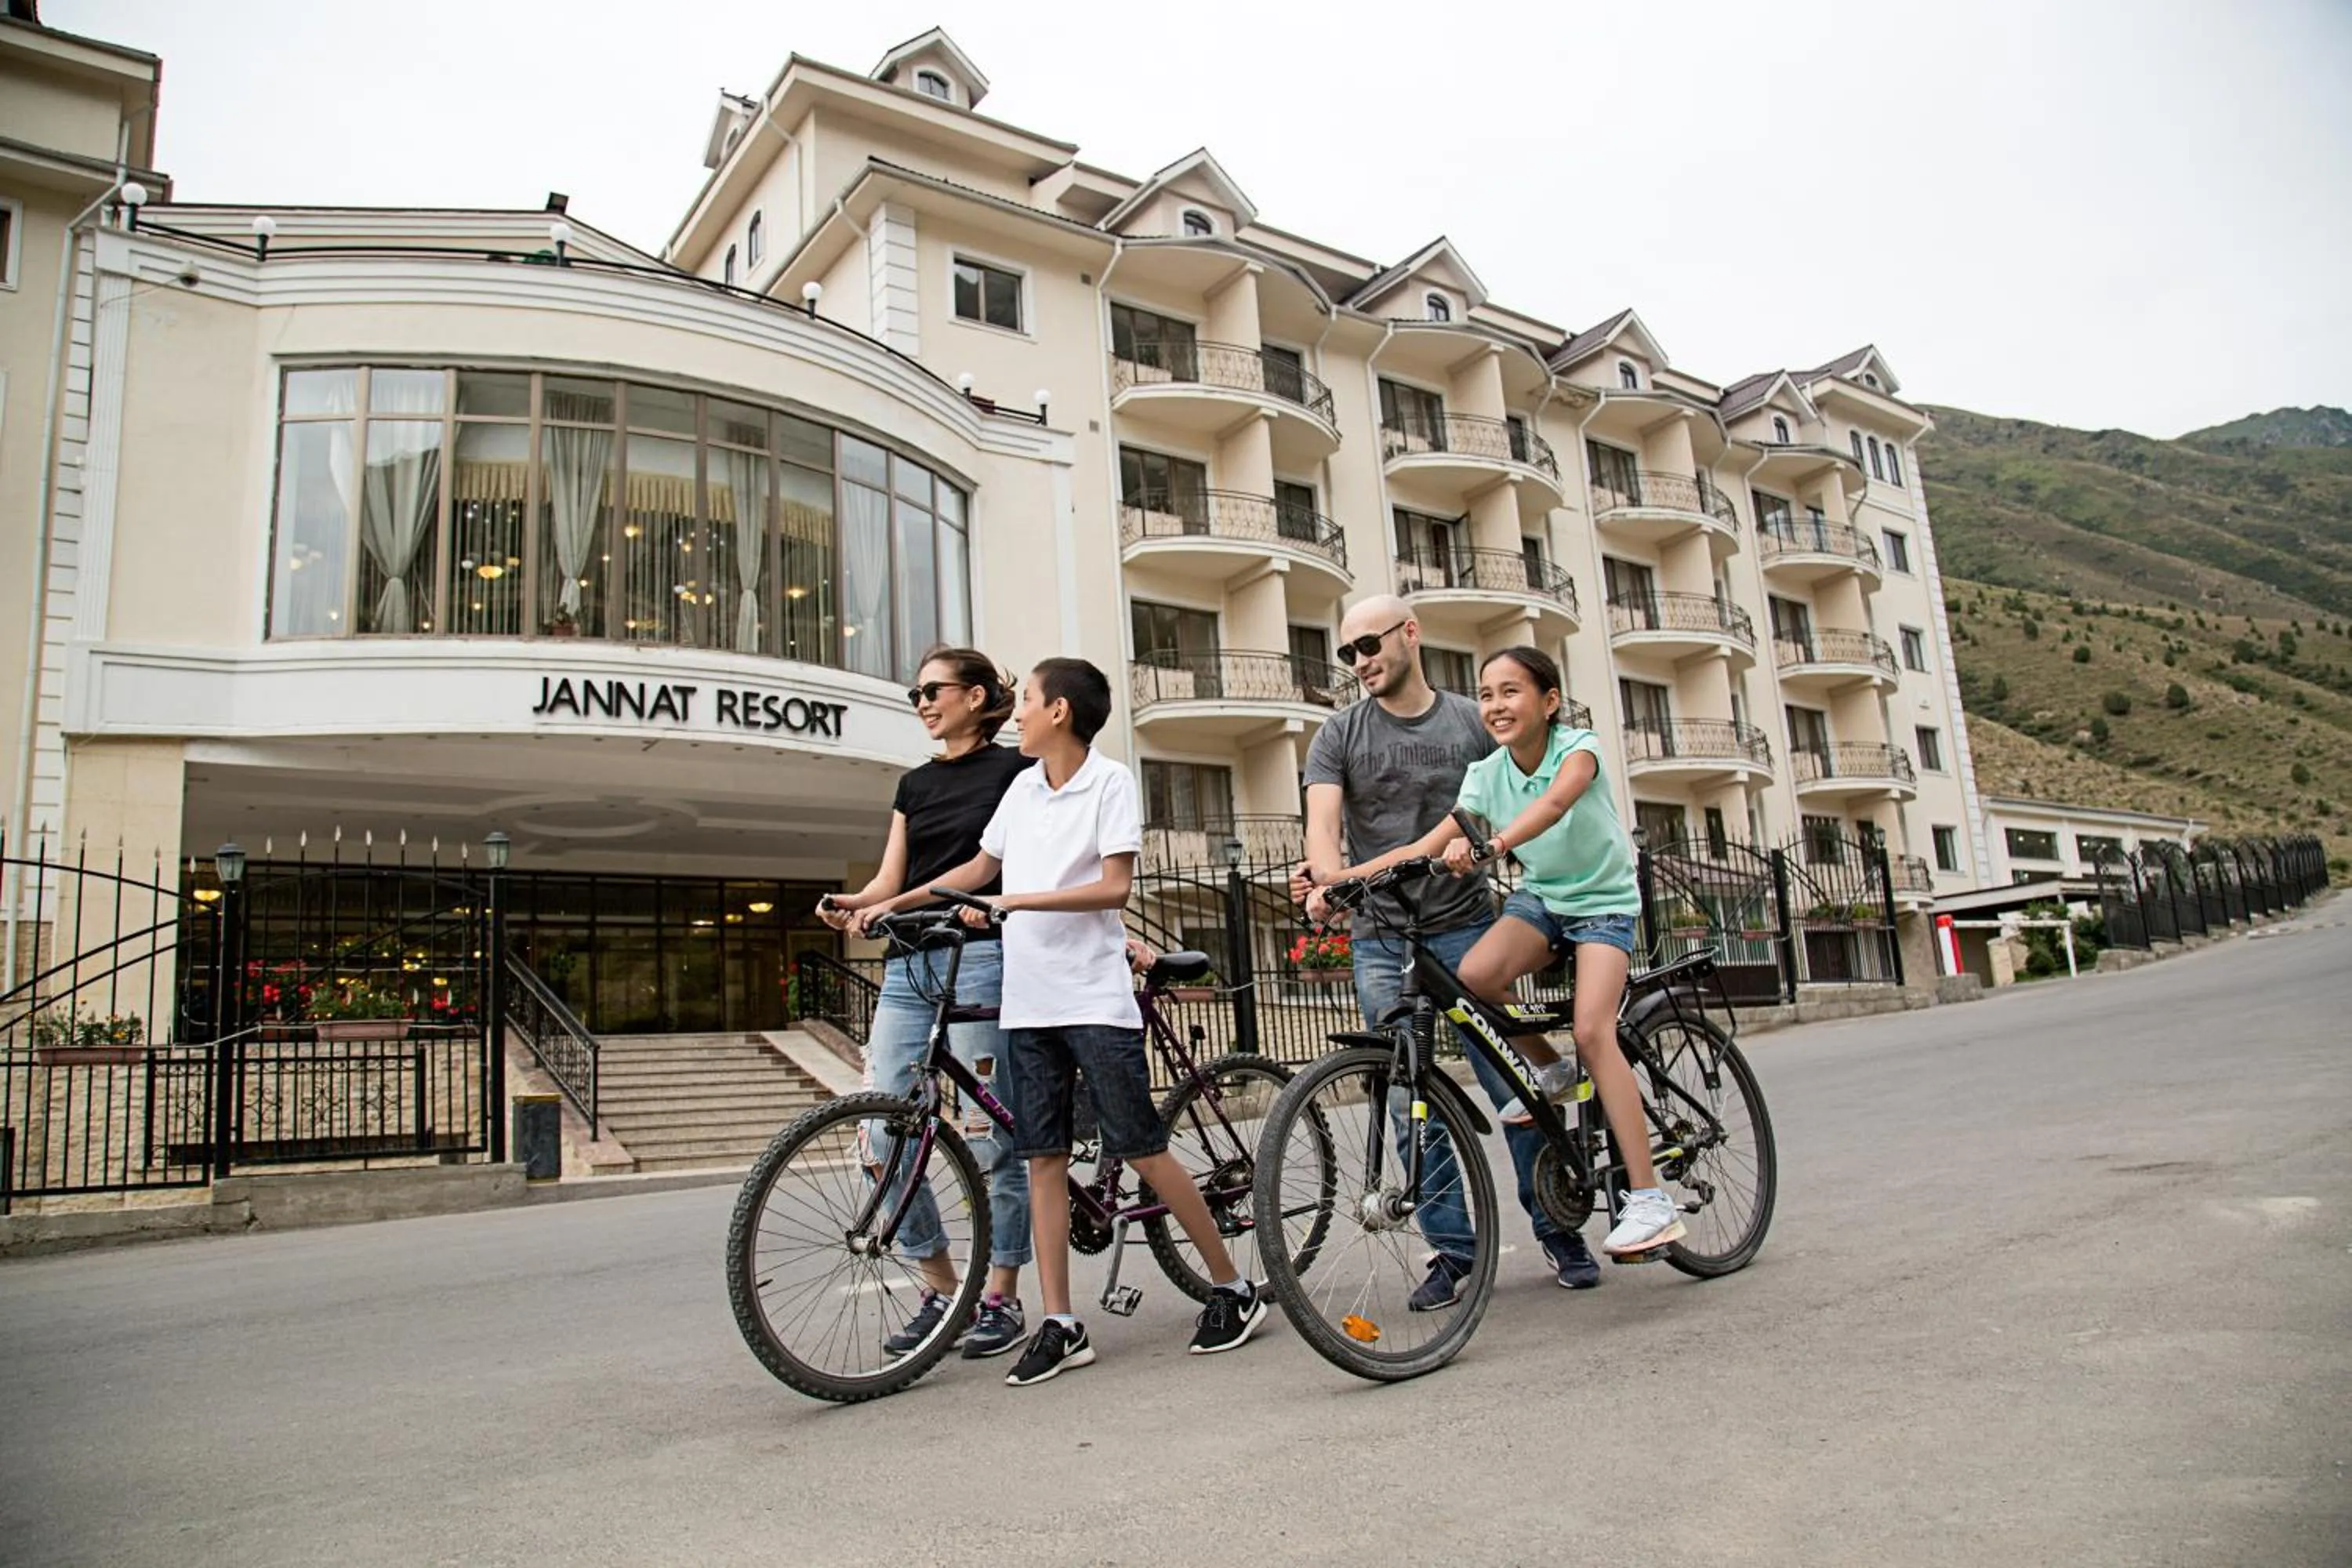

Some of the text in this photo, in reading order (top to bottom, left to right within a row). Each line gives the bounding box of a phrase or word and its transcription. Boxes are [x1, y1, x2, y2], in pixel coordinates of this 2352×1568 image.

[533, 677, 848, 739] JANNAT RESORT
[1456, 997, 1541, 1093] CONWAY
